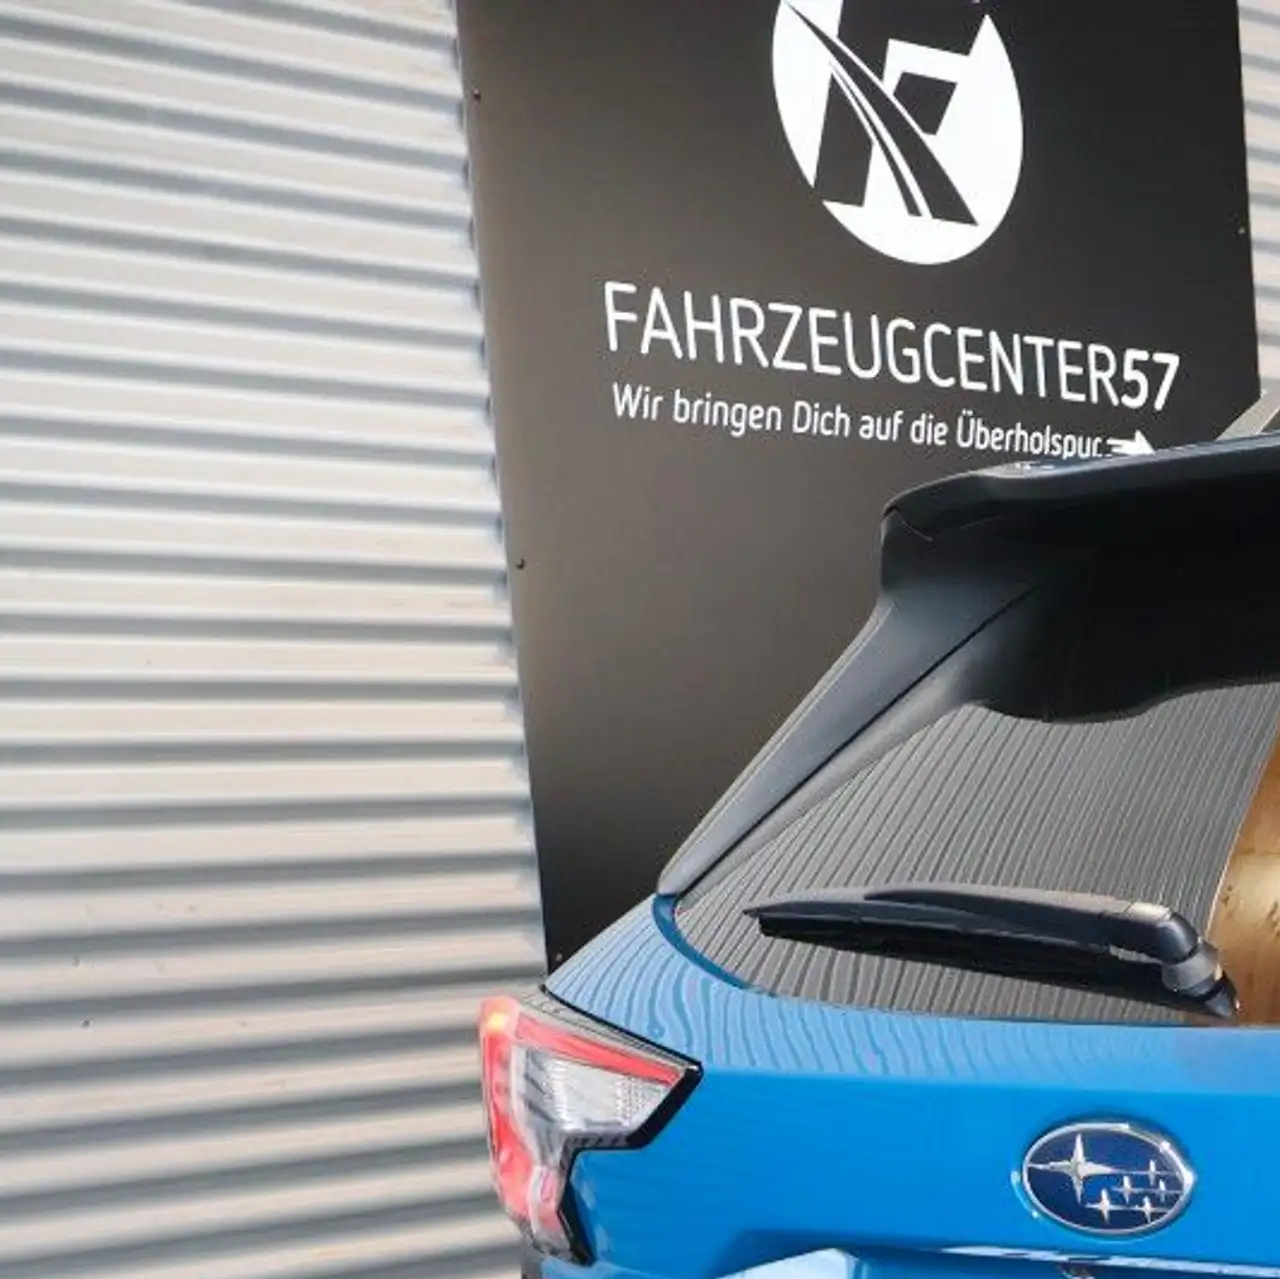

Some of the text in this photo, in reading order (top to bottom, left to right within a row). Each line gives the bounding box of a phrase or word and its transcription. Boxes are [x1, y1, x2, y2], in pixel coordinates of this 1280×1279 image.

[603, 280, 1180, 412] FAHRZEUGCENTER57
[611, 382, 663, 421] Wir
[672, 391, 782, 438] bringen
[792, 401, 850, 438] Dich
[858, 409, 904, 443] auf
[909, 418, 948, 447] die
